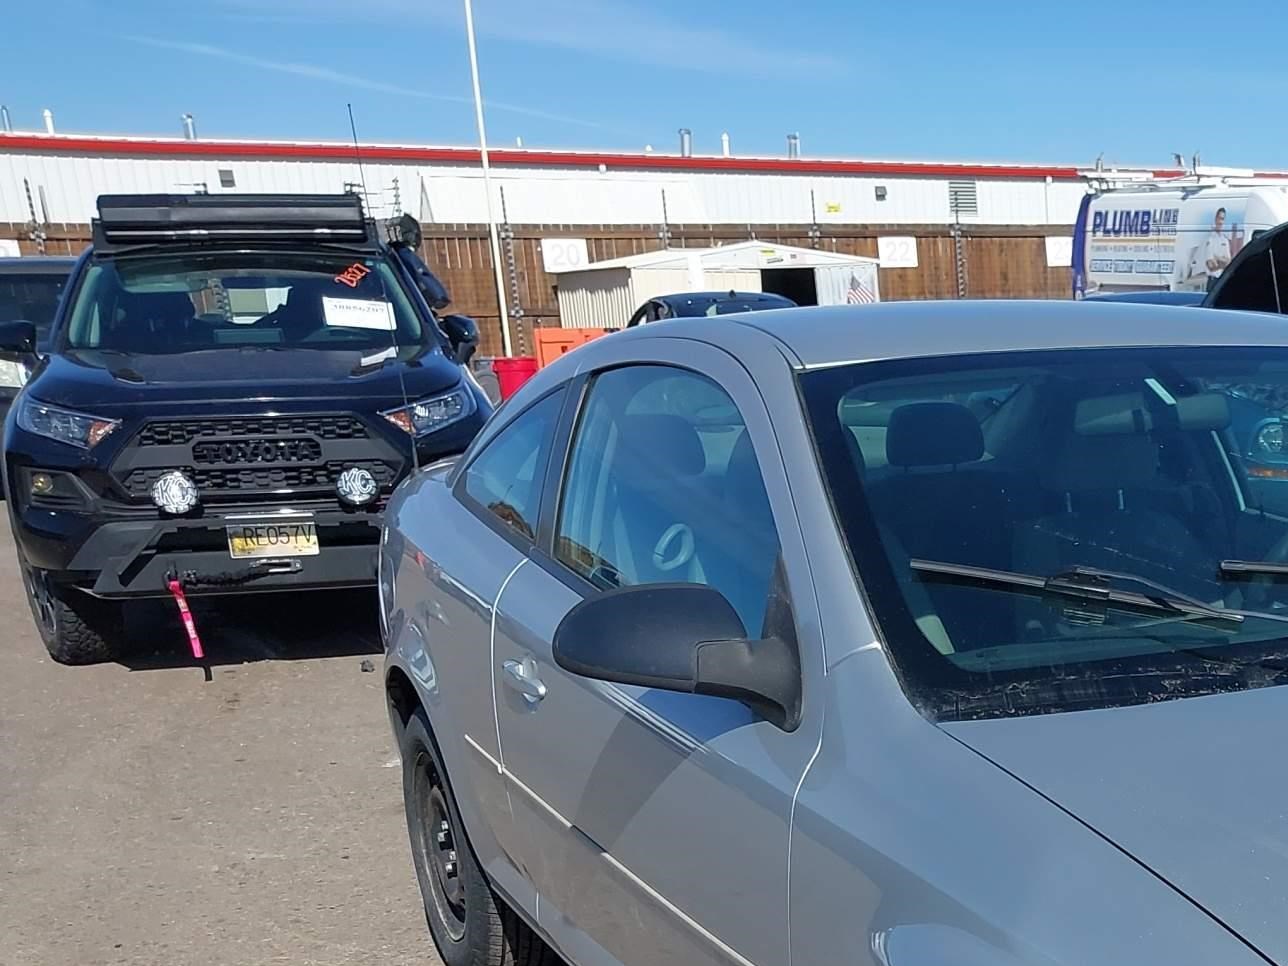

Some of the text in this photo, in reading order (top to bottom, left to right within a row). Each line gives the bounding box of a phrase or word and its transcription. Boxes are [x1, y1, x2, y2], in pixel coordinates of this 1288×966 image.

[1093, 210, 1151, 236] PLUMB
[551, 243, 580, 266] 20
[203, 440, 315, 464] TOYOTA
[157, 475, 192, 504] KC
[343, 467, 372, 494] KC
